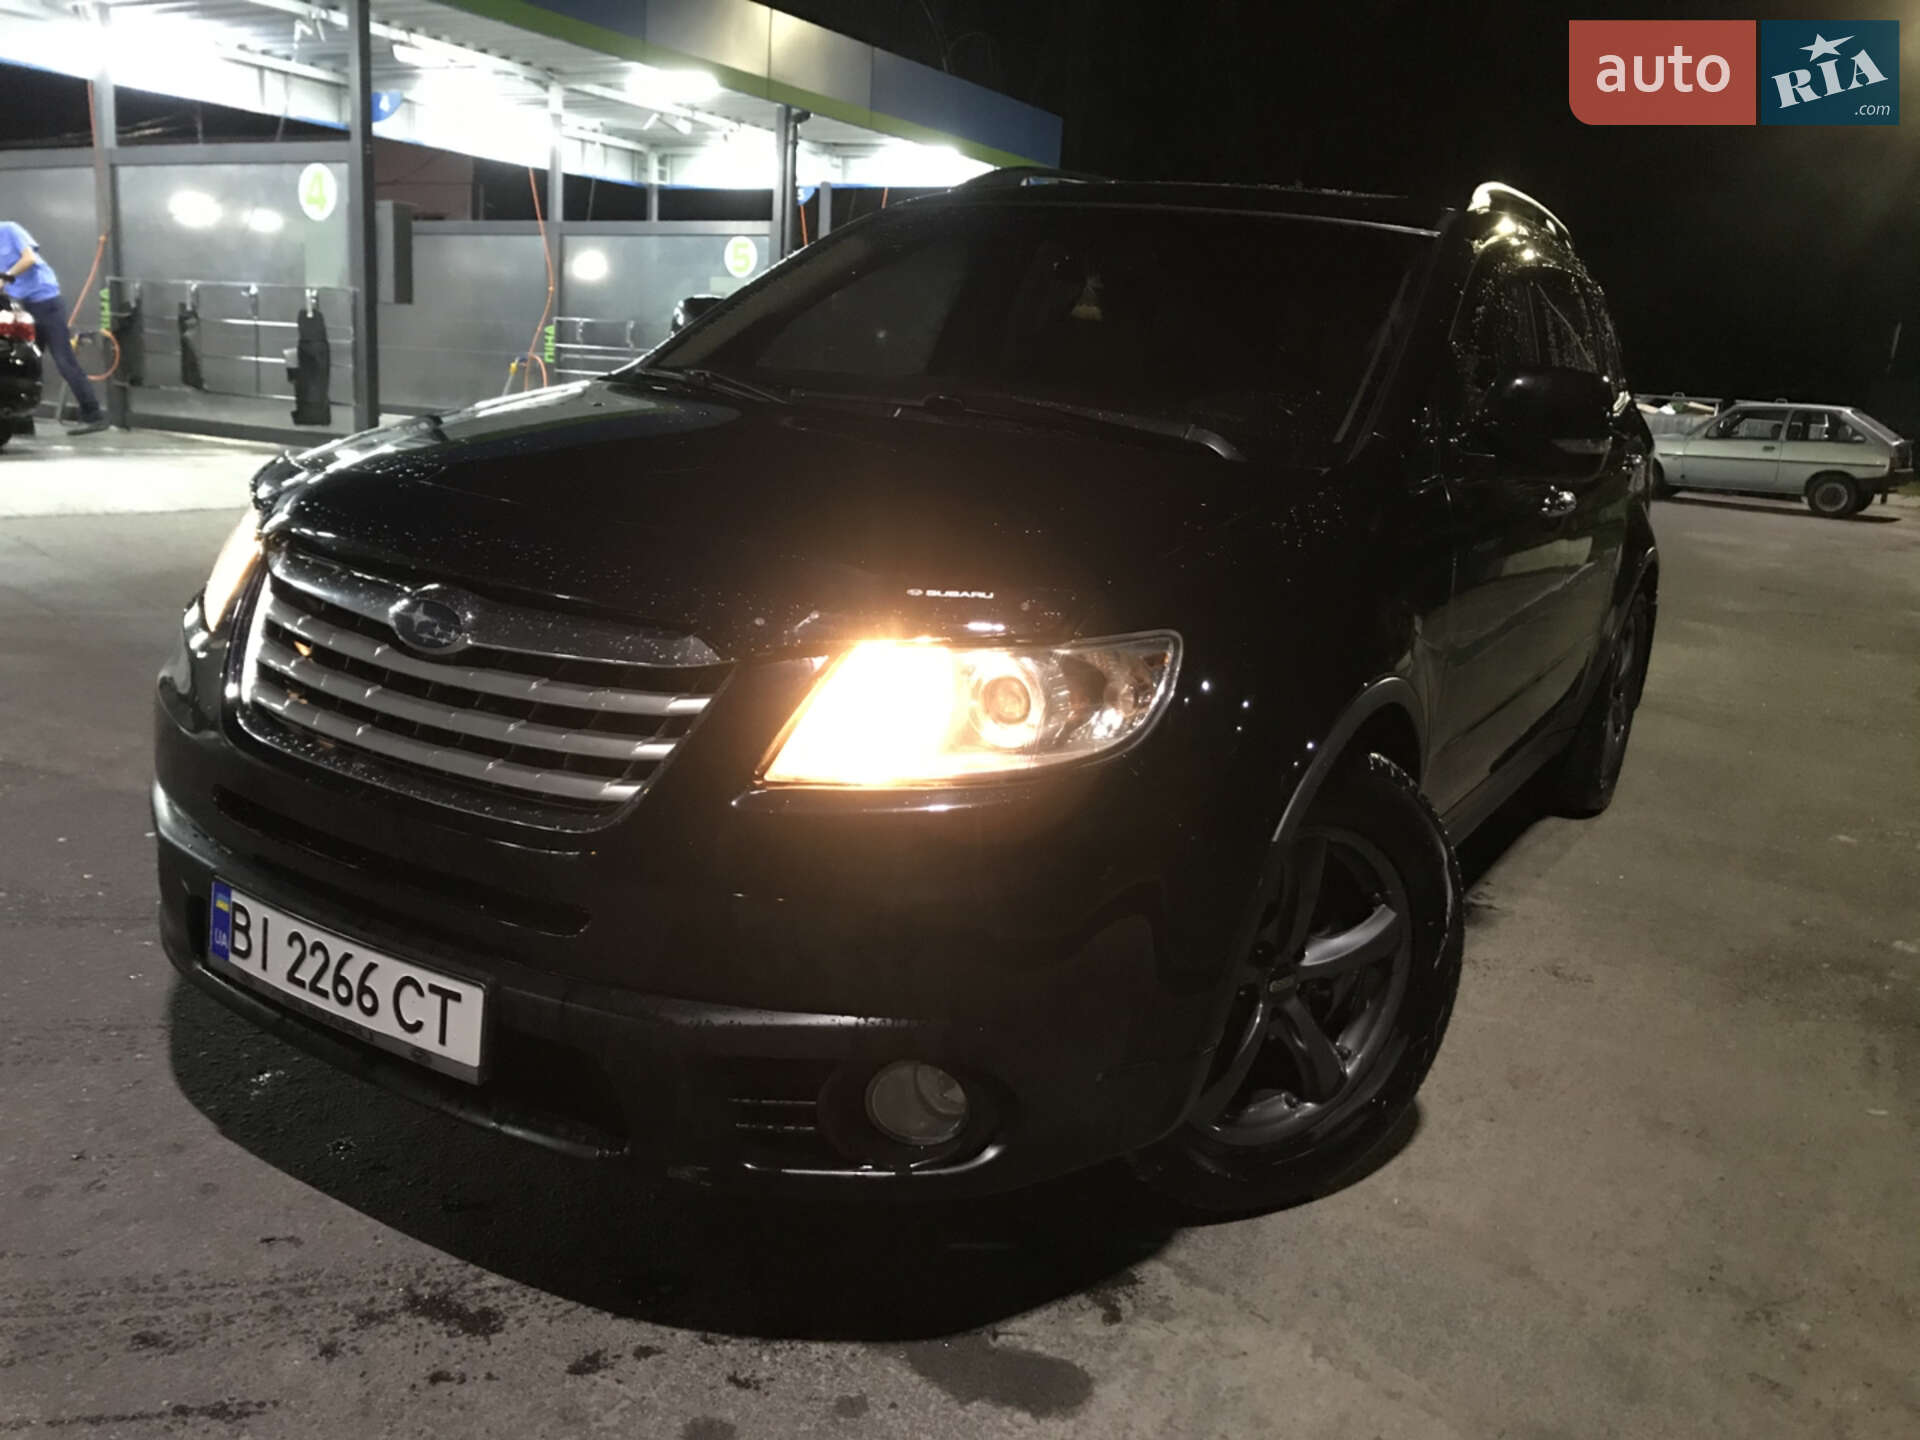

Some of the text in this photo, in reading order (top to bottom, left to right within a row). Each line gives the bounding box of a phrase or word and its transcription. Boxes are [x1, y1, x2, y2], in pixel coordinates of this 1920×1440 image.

[306, 170, 328, 213] 4
[732, 241, 751, 273] 5
[925, 589, 995, 600] SUBARU
[215, 928, 228, 947] UA
[231, 900, 270, 971] BI
[286, 931, 379, 1018] 2266
[393, 975, 462, 1046] CT
